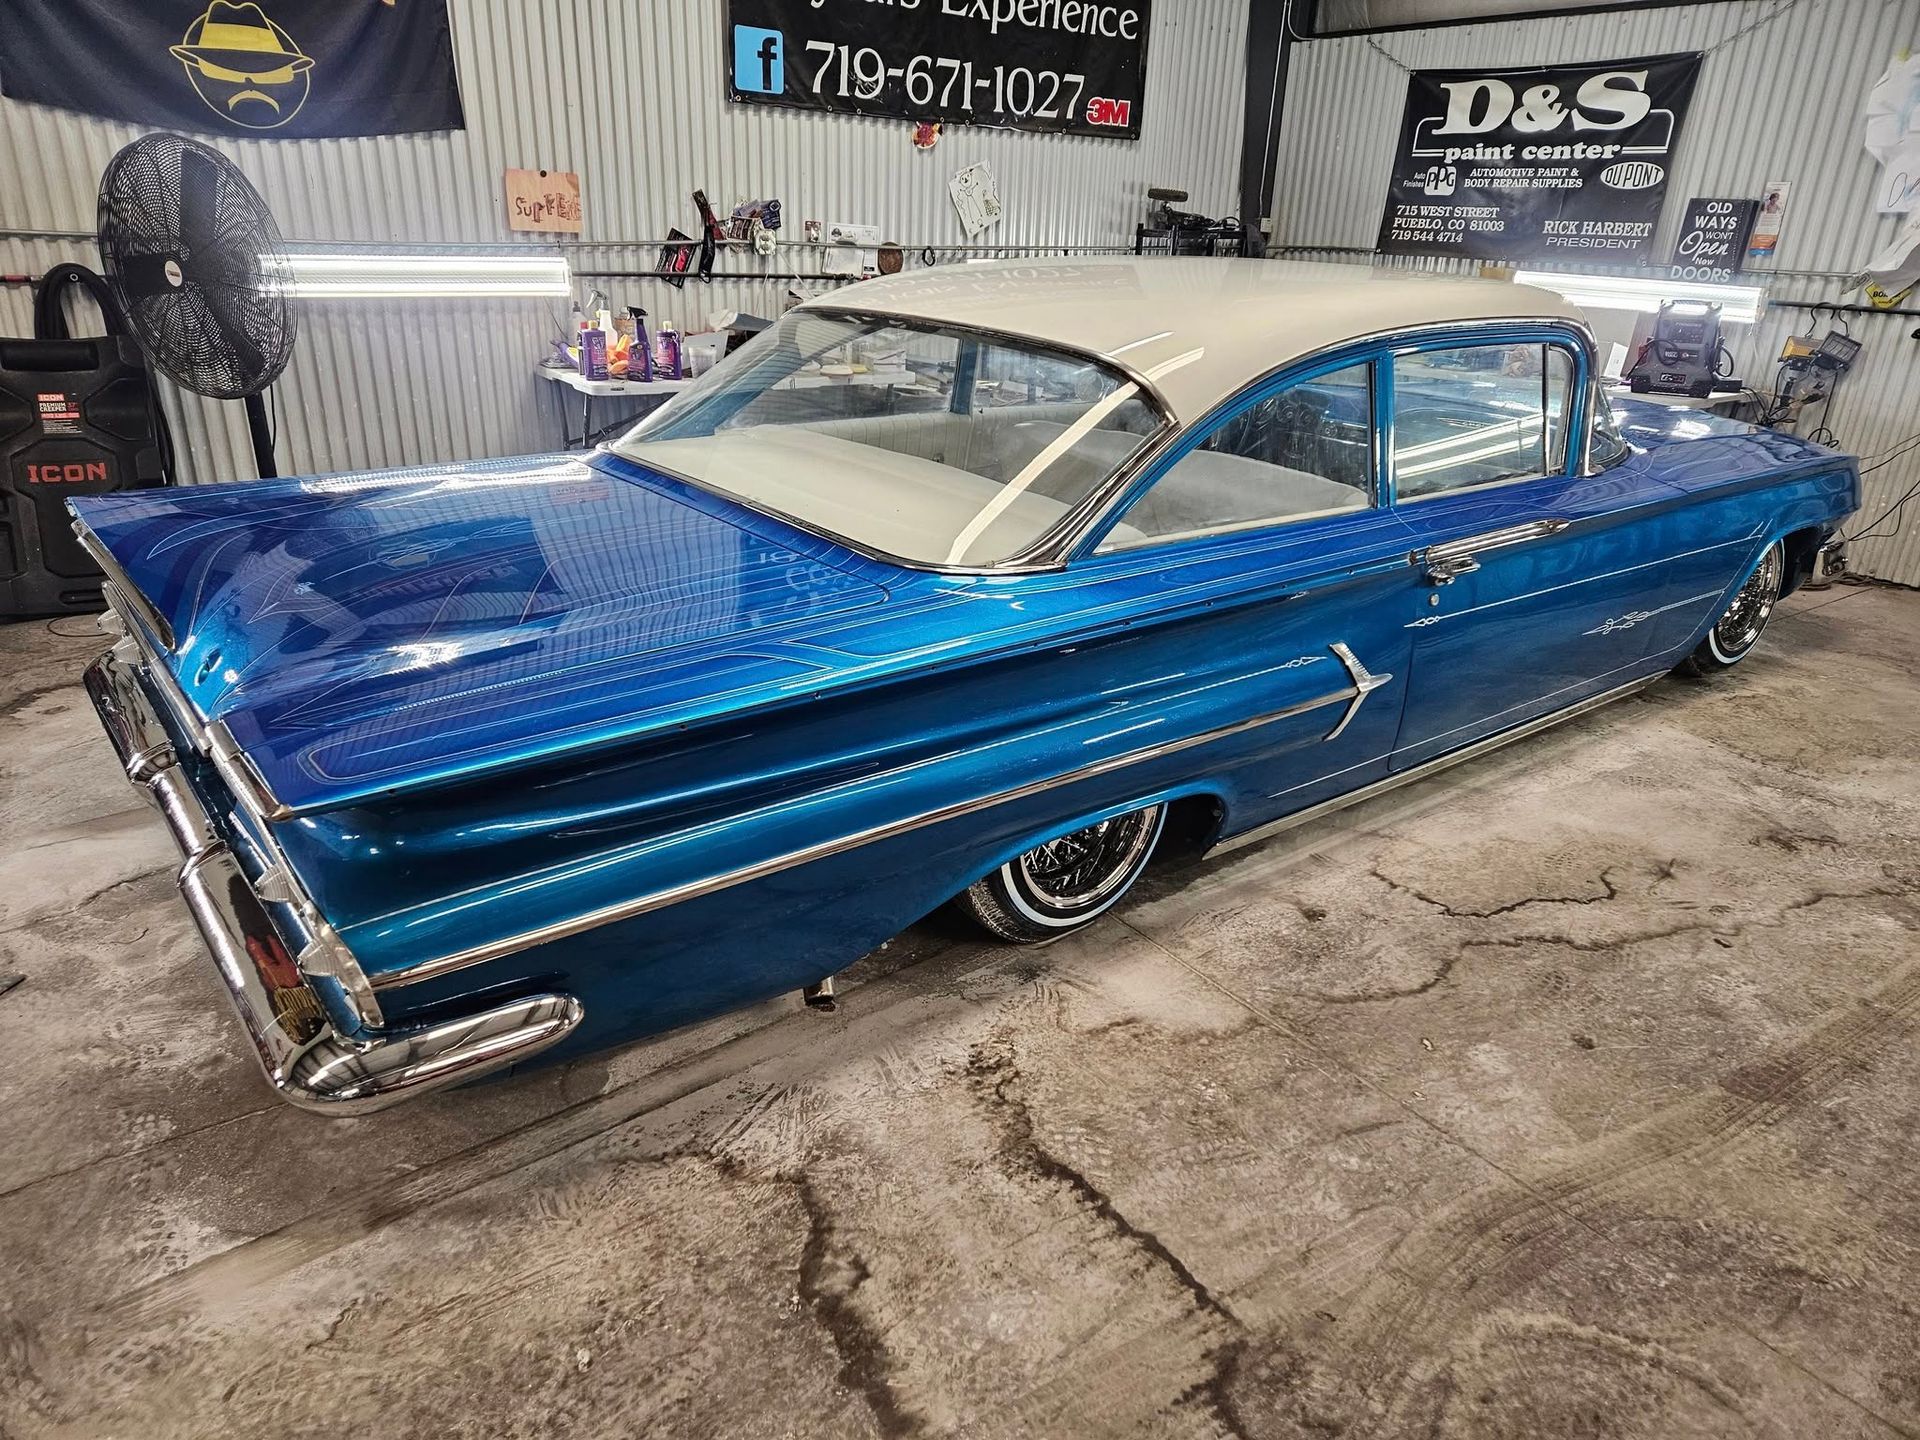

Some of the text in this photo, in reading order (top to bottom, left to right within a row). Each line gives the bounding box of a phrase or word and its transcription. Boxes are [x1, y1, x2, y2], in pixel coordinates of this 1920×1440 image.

[804, 40, 1085, 119] 719-671-1027
[1431, 70, 1651, 135] D&S
[1086, 97, 1130, 127] 3M
[1444, 141, 1621, 163] paint center
[1470, 167, 1579, 177] AUTOMOTIVE PAINT &
[1463, 178, 1583, 188] BODY REPAIR SUPPLIES
[1396, 205, 1500, 218] 715 WEST STREET
[1706, 201, 1733, 214] OLD
[1393, 217, 1504, 232] PUEBLO, CO 81003
[1542, 220, 1653, 237] RICK HARBERT
[1695, 215, 1738, 230] WAYS
[1391, 229, 1464, 243] 719 544 4714
[1545, 236, 1641, 249] PRESIDENT
[1679, 230, 1730, 261] Open
[1695, 257, 1715, 265] Now
[1671, 265, 1732, 283] DOORS
[27, 463, 107, 483] ICON
